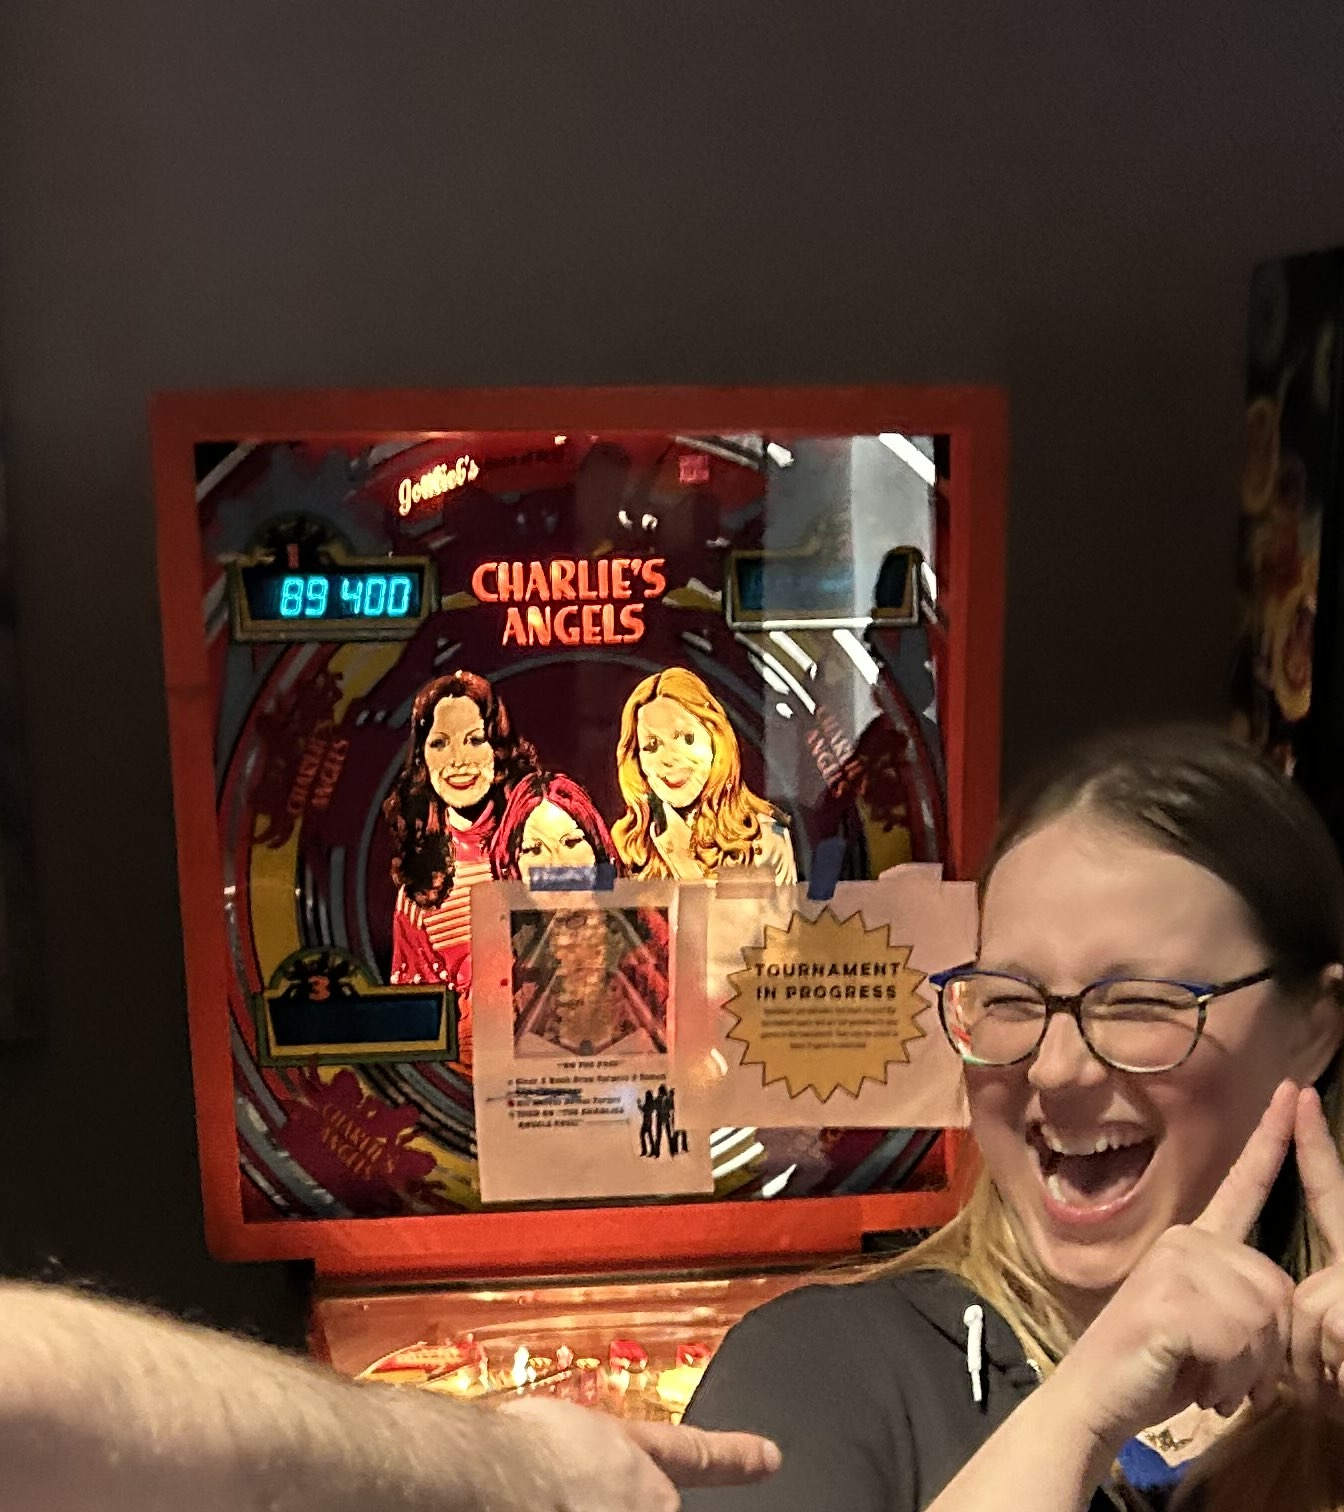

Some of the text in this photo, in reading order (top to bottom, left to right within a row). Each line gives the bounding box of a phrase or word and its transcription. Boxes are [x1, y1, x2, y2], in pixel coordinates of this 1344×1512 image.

[471, 558, 666, 602] CHARLIE'S
[501, 603, 645, 646] ANGELS
[755, 961, 901, 978] TOURNAMENT
[756, 984, 897, 1000] IN PROGRESS
